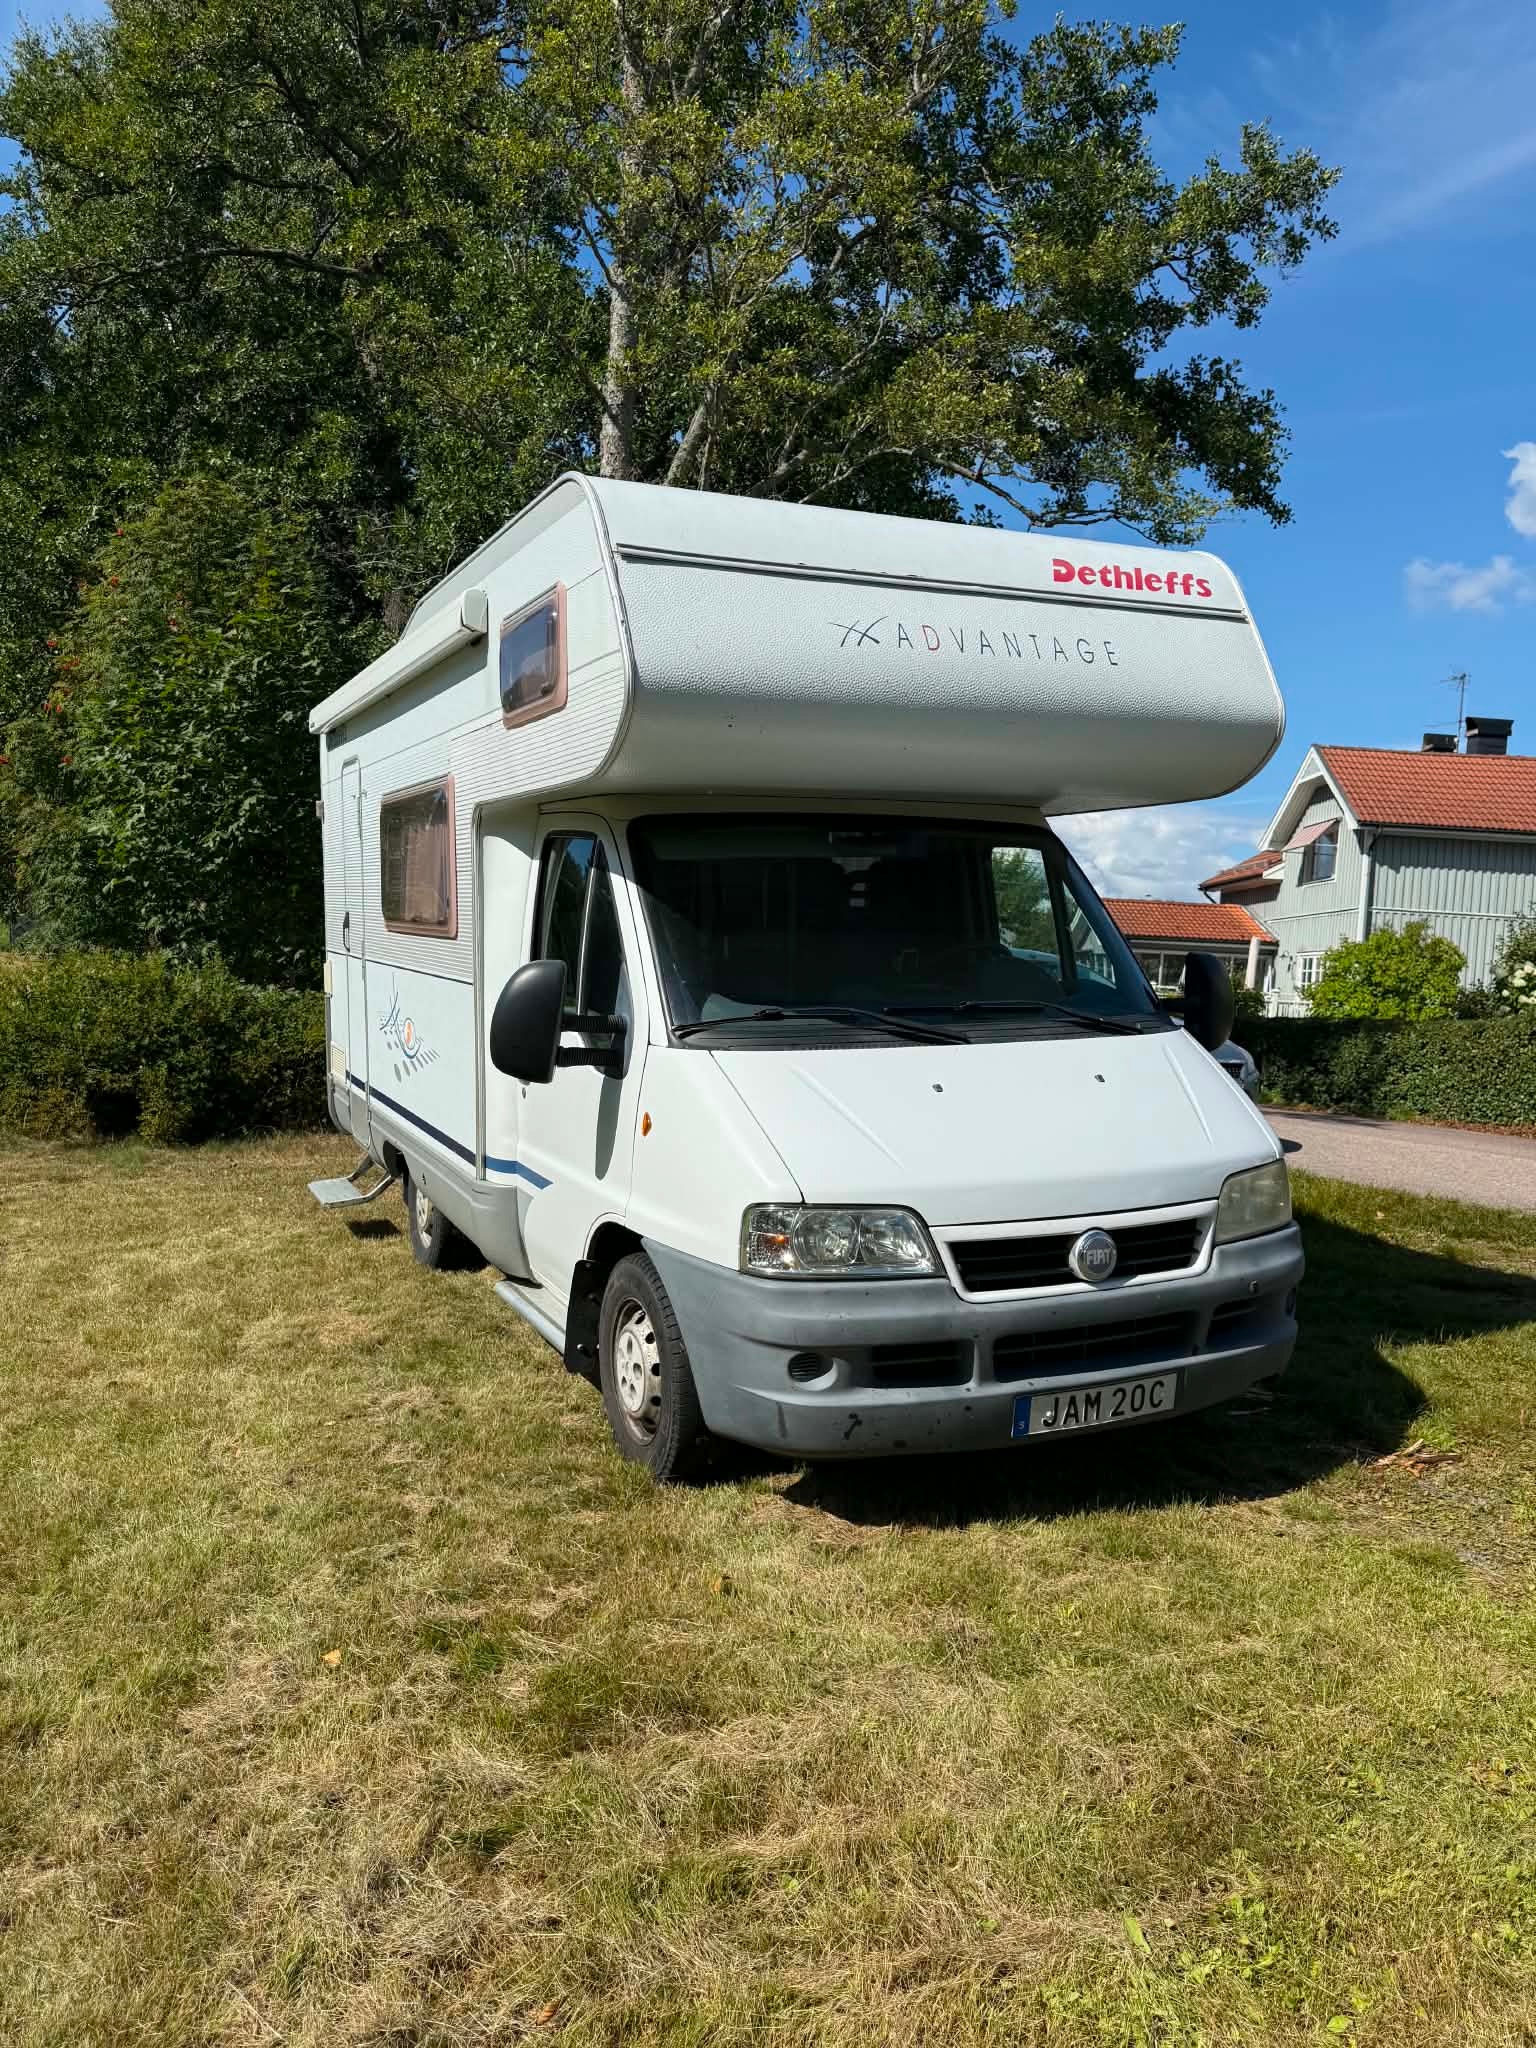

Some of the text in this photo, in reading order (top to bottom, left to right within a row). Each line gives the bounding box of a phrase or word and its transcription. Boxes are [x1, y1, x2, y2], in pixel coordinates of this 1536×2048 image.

[1052, 558, 1213, 598] Dethleffs
[898, 622, 1119, 665] ADVANTAGE
[1086, 1249, 1110, 1265] FIAT
[1042, 1379, 1165, 1427] JAM 20C
